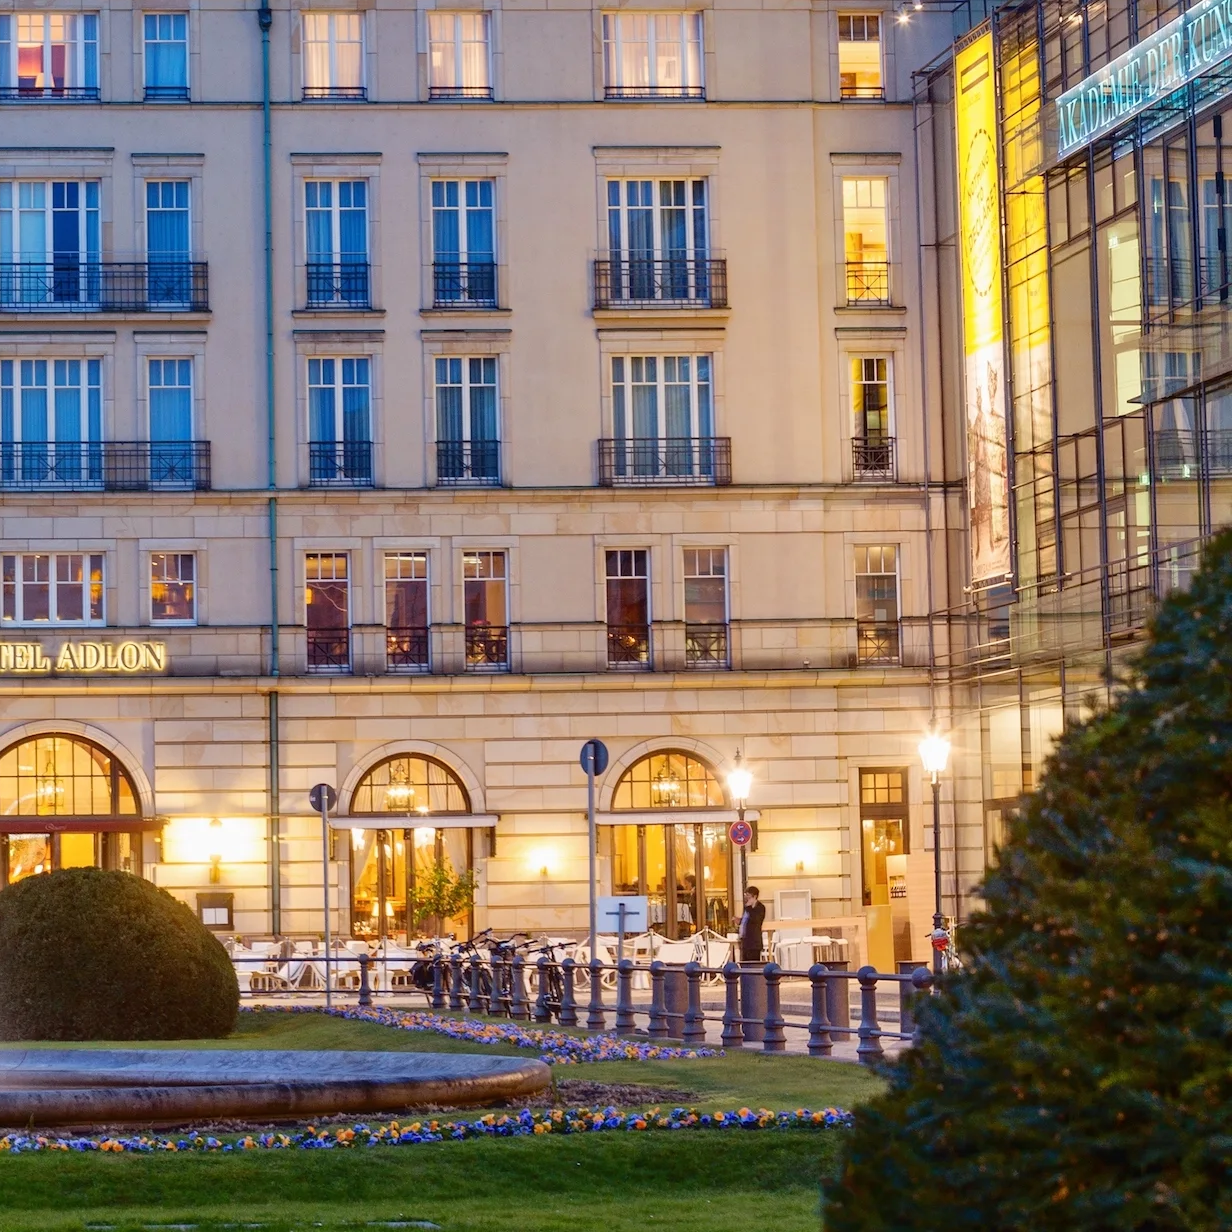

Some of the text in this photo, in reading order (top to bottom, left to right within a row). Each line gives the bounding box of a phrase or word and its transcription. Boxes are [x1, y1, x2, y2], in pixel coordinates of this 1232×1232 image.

[1058, 59, 1143, 152] AKADEMIE
[1146, 32, 1187, 98] DER
[55, 642, 165, 671] ADLON
